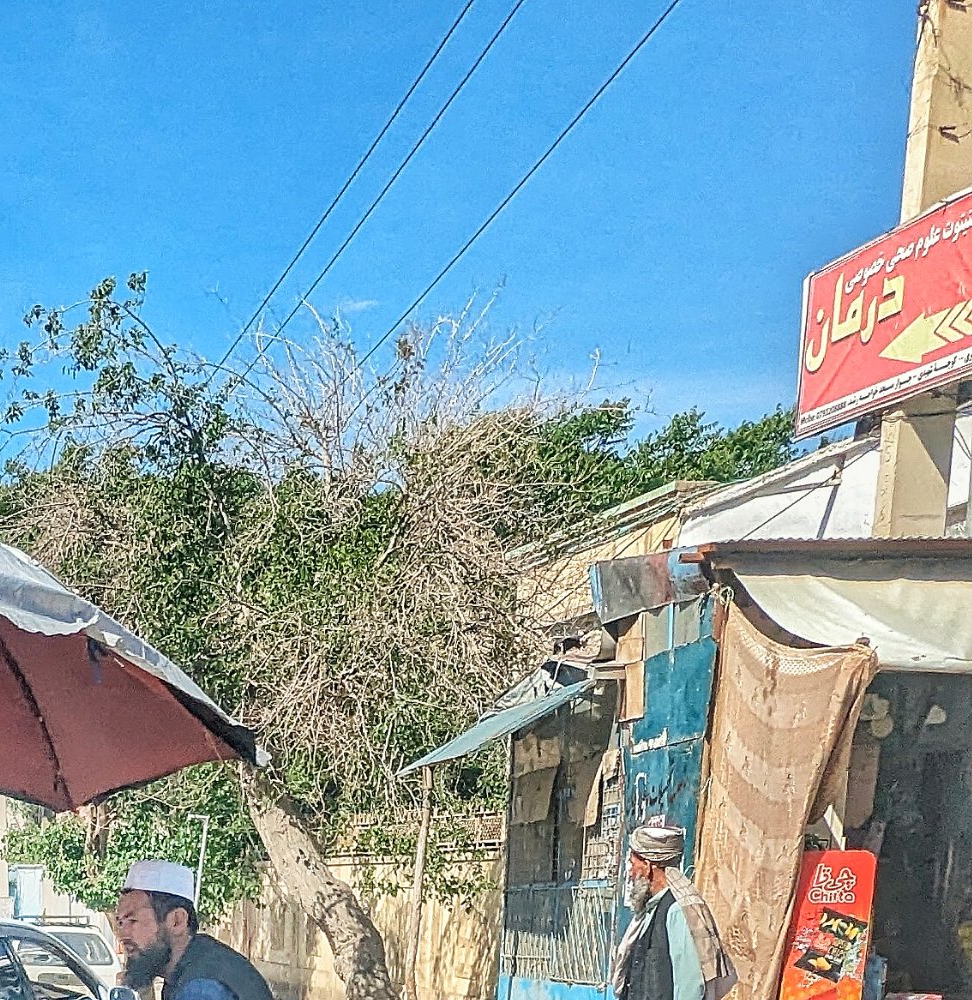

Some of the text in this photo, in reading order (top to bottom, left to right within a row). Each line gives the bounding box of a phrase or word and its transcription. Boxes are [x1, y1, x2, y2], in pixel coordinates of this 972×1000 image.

[915, 224, 941, 261] علوم
[844, 251, 885, 294] خصوصی
[805, 271, 905, 373] درمان
